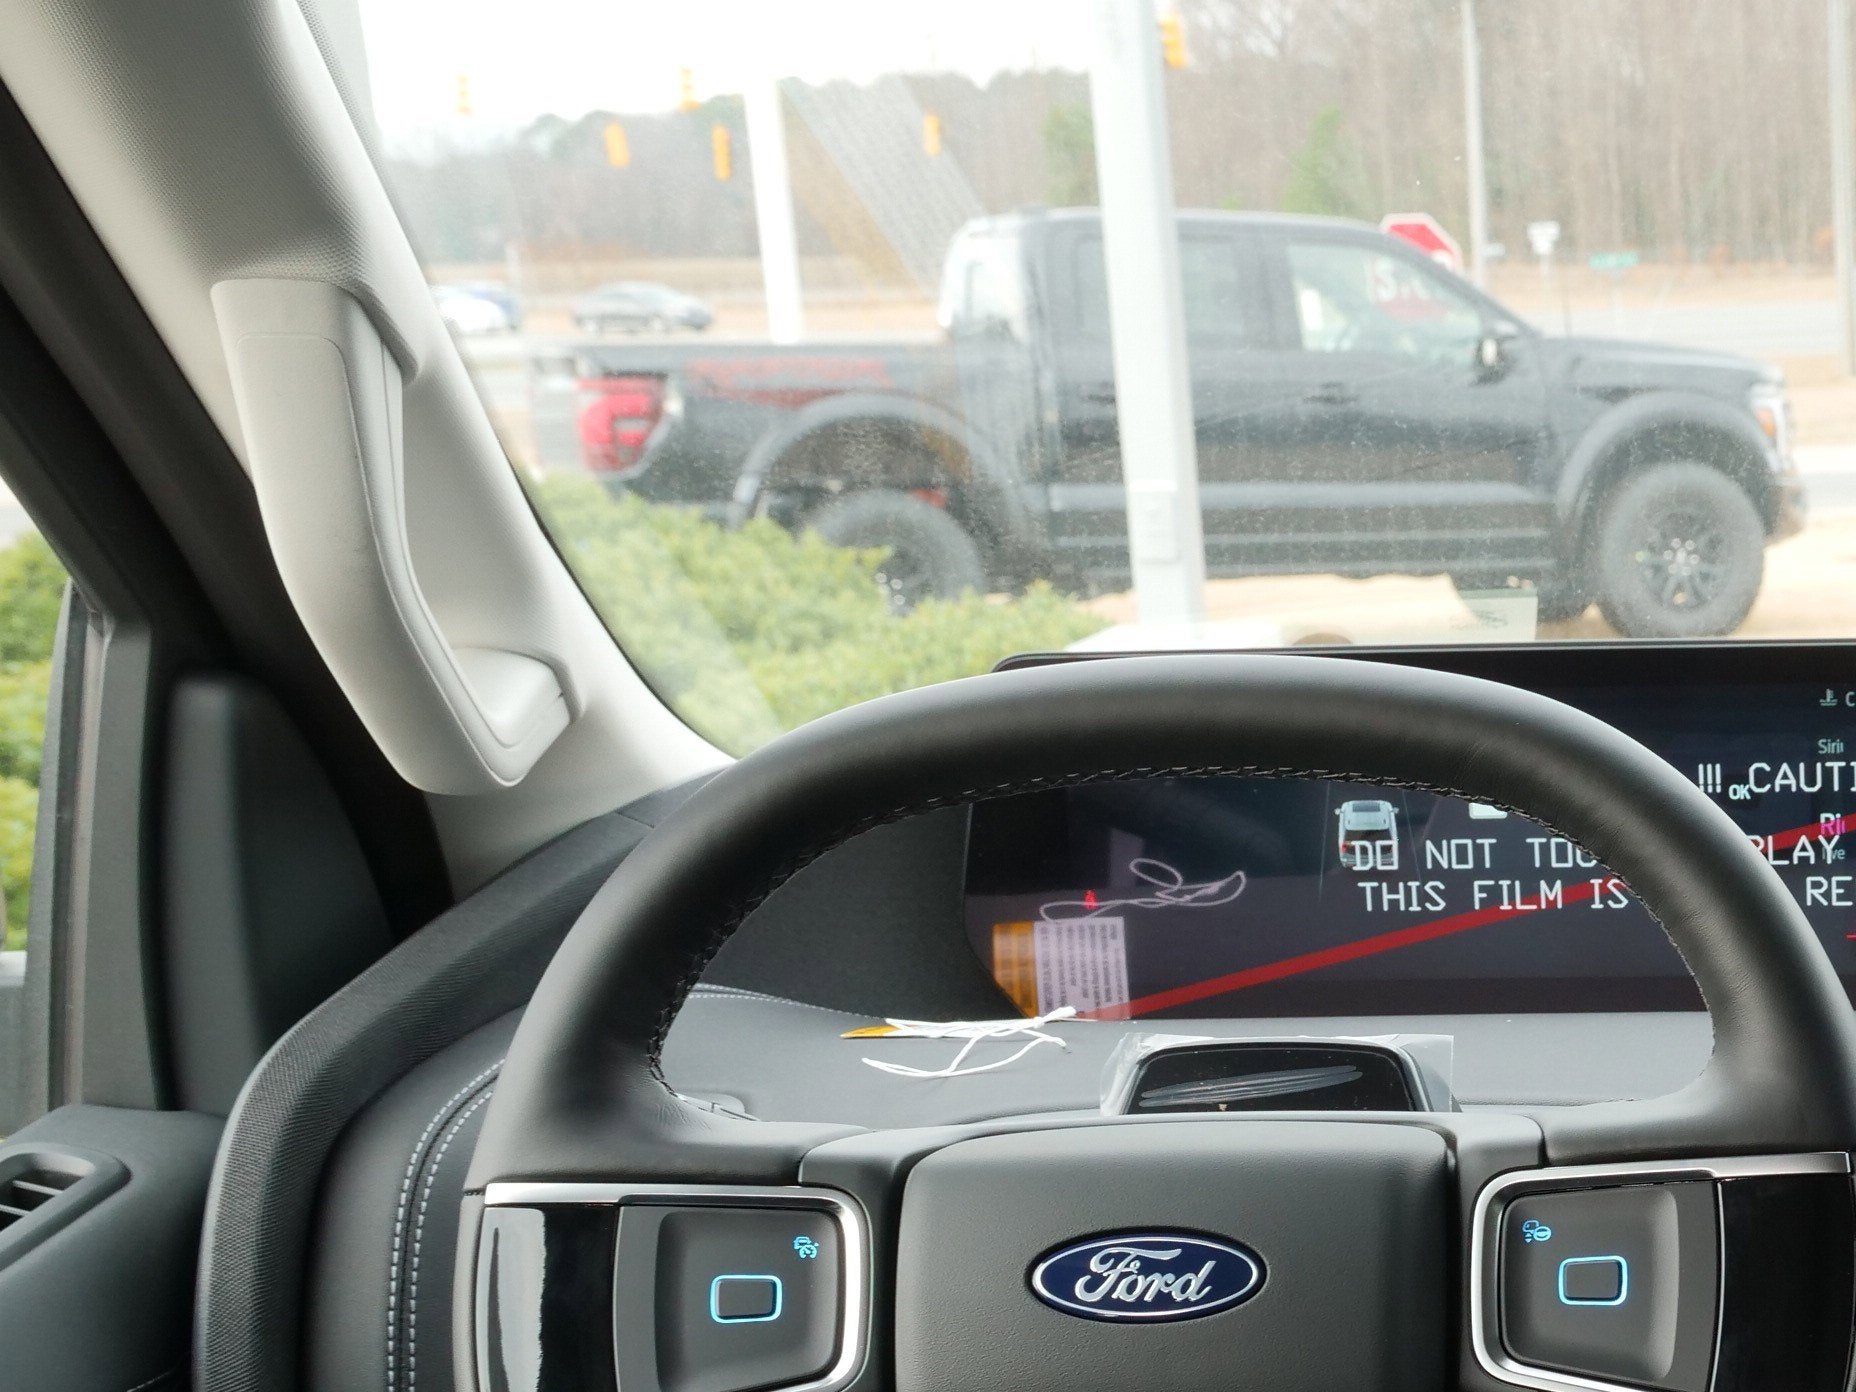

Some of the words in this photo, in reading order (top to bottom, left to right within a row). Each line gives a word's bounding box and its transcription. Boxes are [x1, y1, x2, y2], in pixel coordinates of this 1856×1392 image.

[1729, 784, 1750, 800] OK
[1351, 840, 1399, 870] DO
[1425, 839, 1498, 869] NOT
[1357, 881, 1447, 911] THIS
[1473, 880, 1563, 910] FILM
[1590, 878, 1629, 908] IS
[1075, 1247, 1217, 1303] Ford
